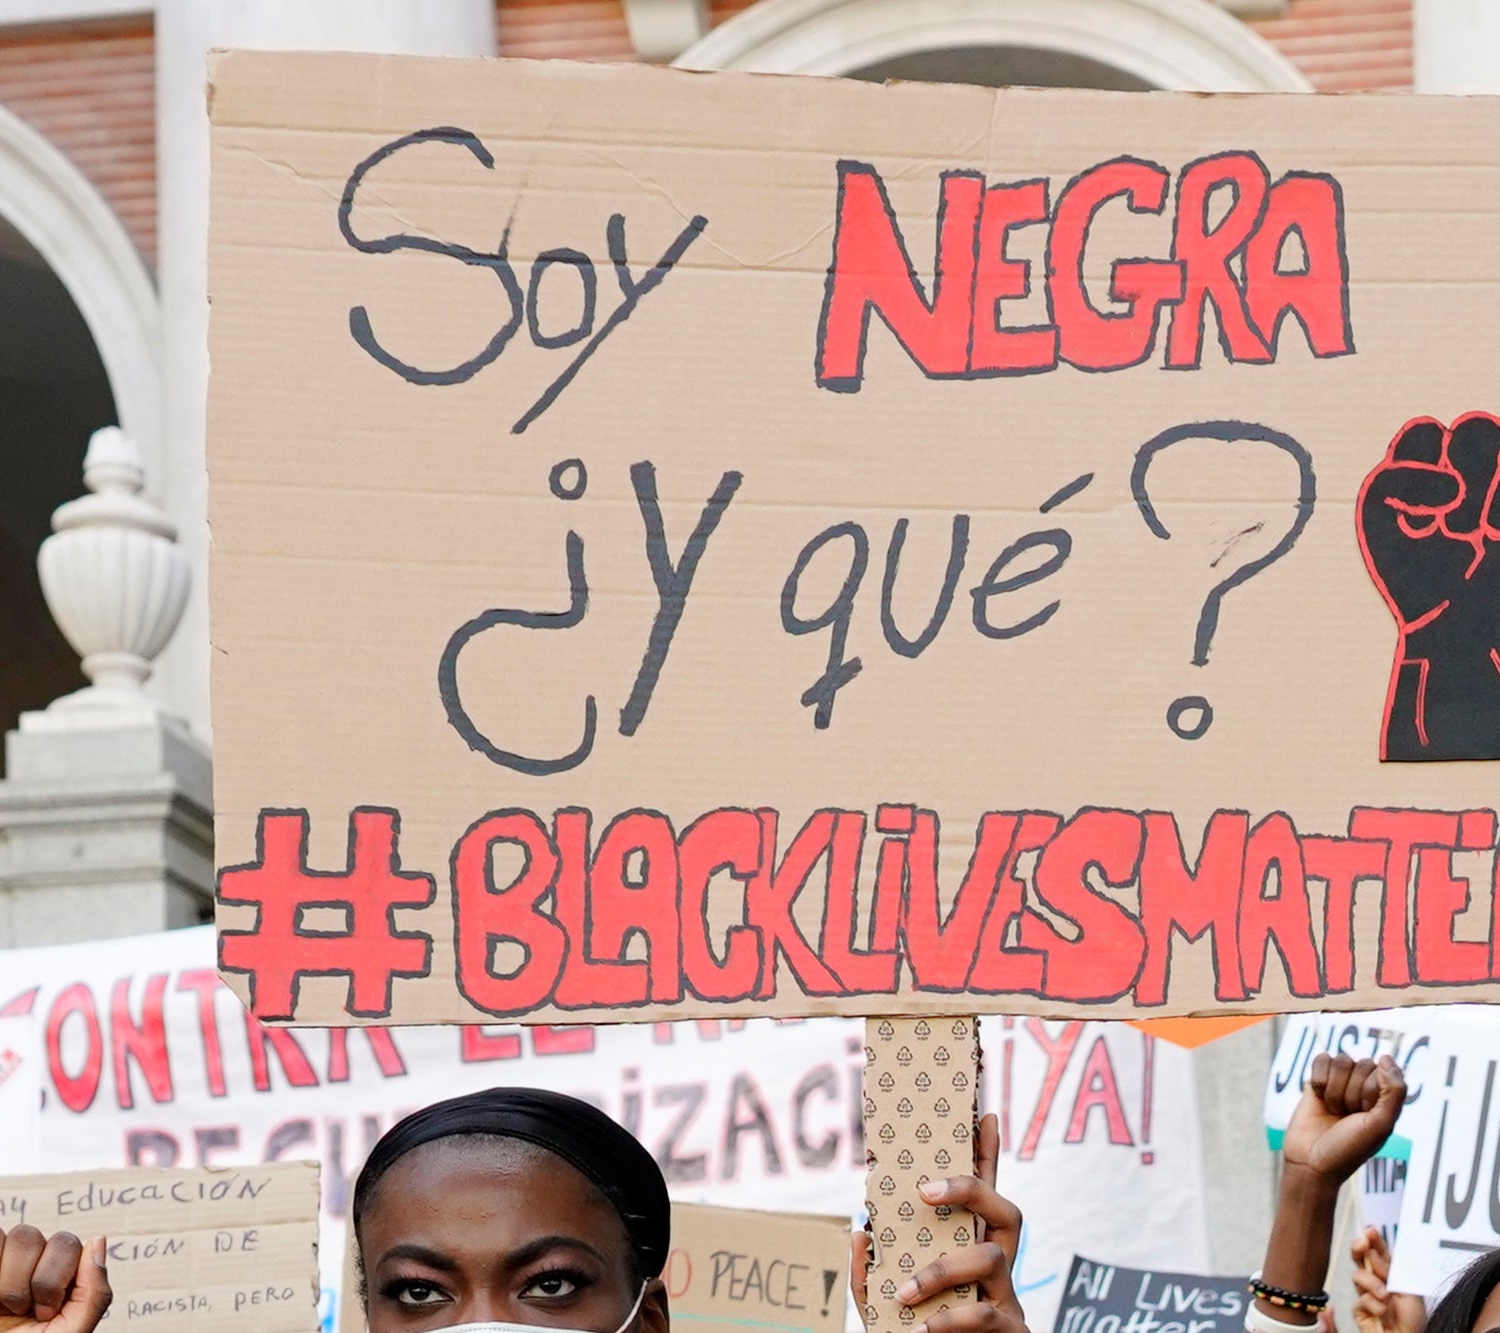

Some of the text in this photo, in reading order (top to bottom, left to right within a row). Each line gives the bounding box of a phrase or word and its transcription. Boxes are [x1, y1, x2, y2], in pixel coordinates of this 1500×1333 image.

[338, 124, 1355, 433] Soy NEGRA
[214, 1229, 262, 1255] DE
[1135, 1272, 1242, 1317] Lives
